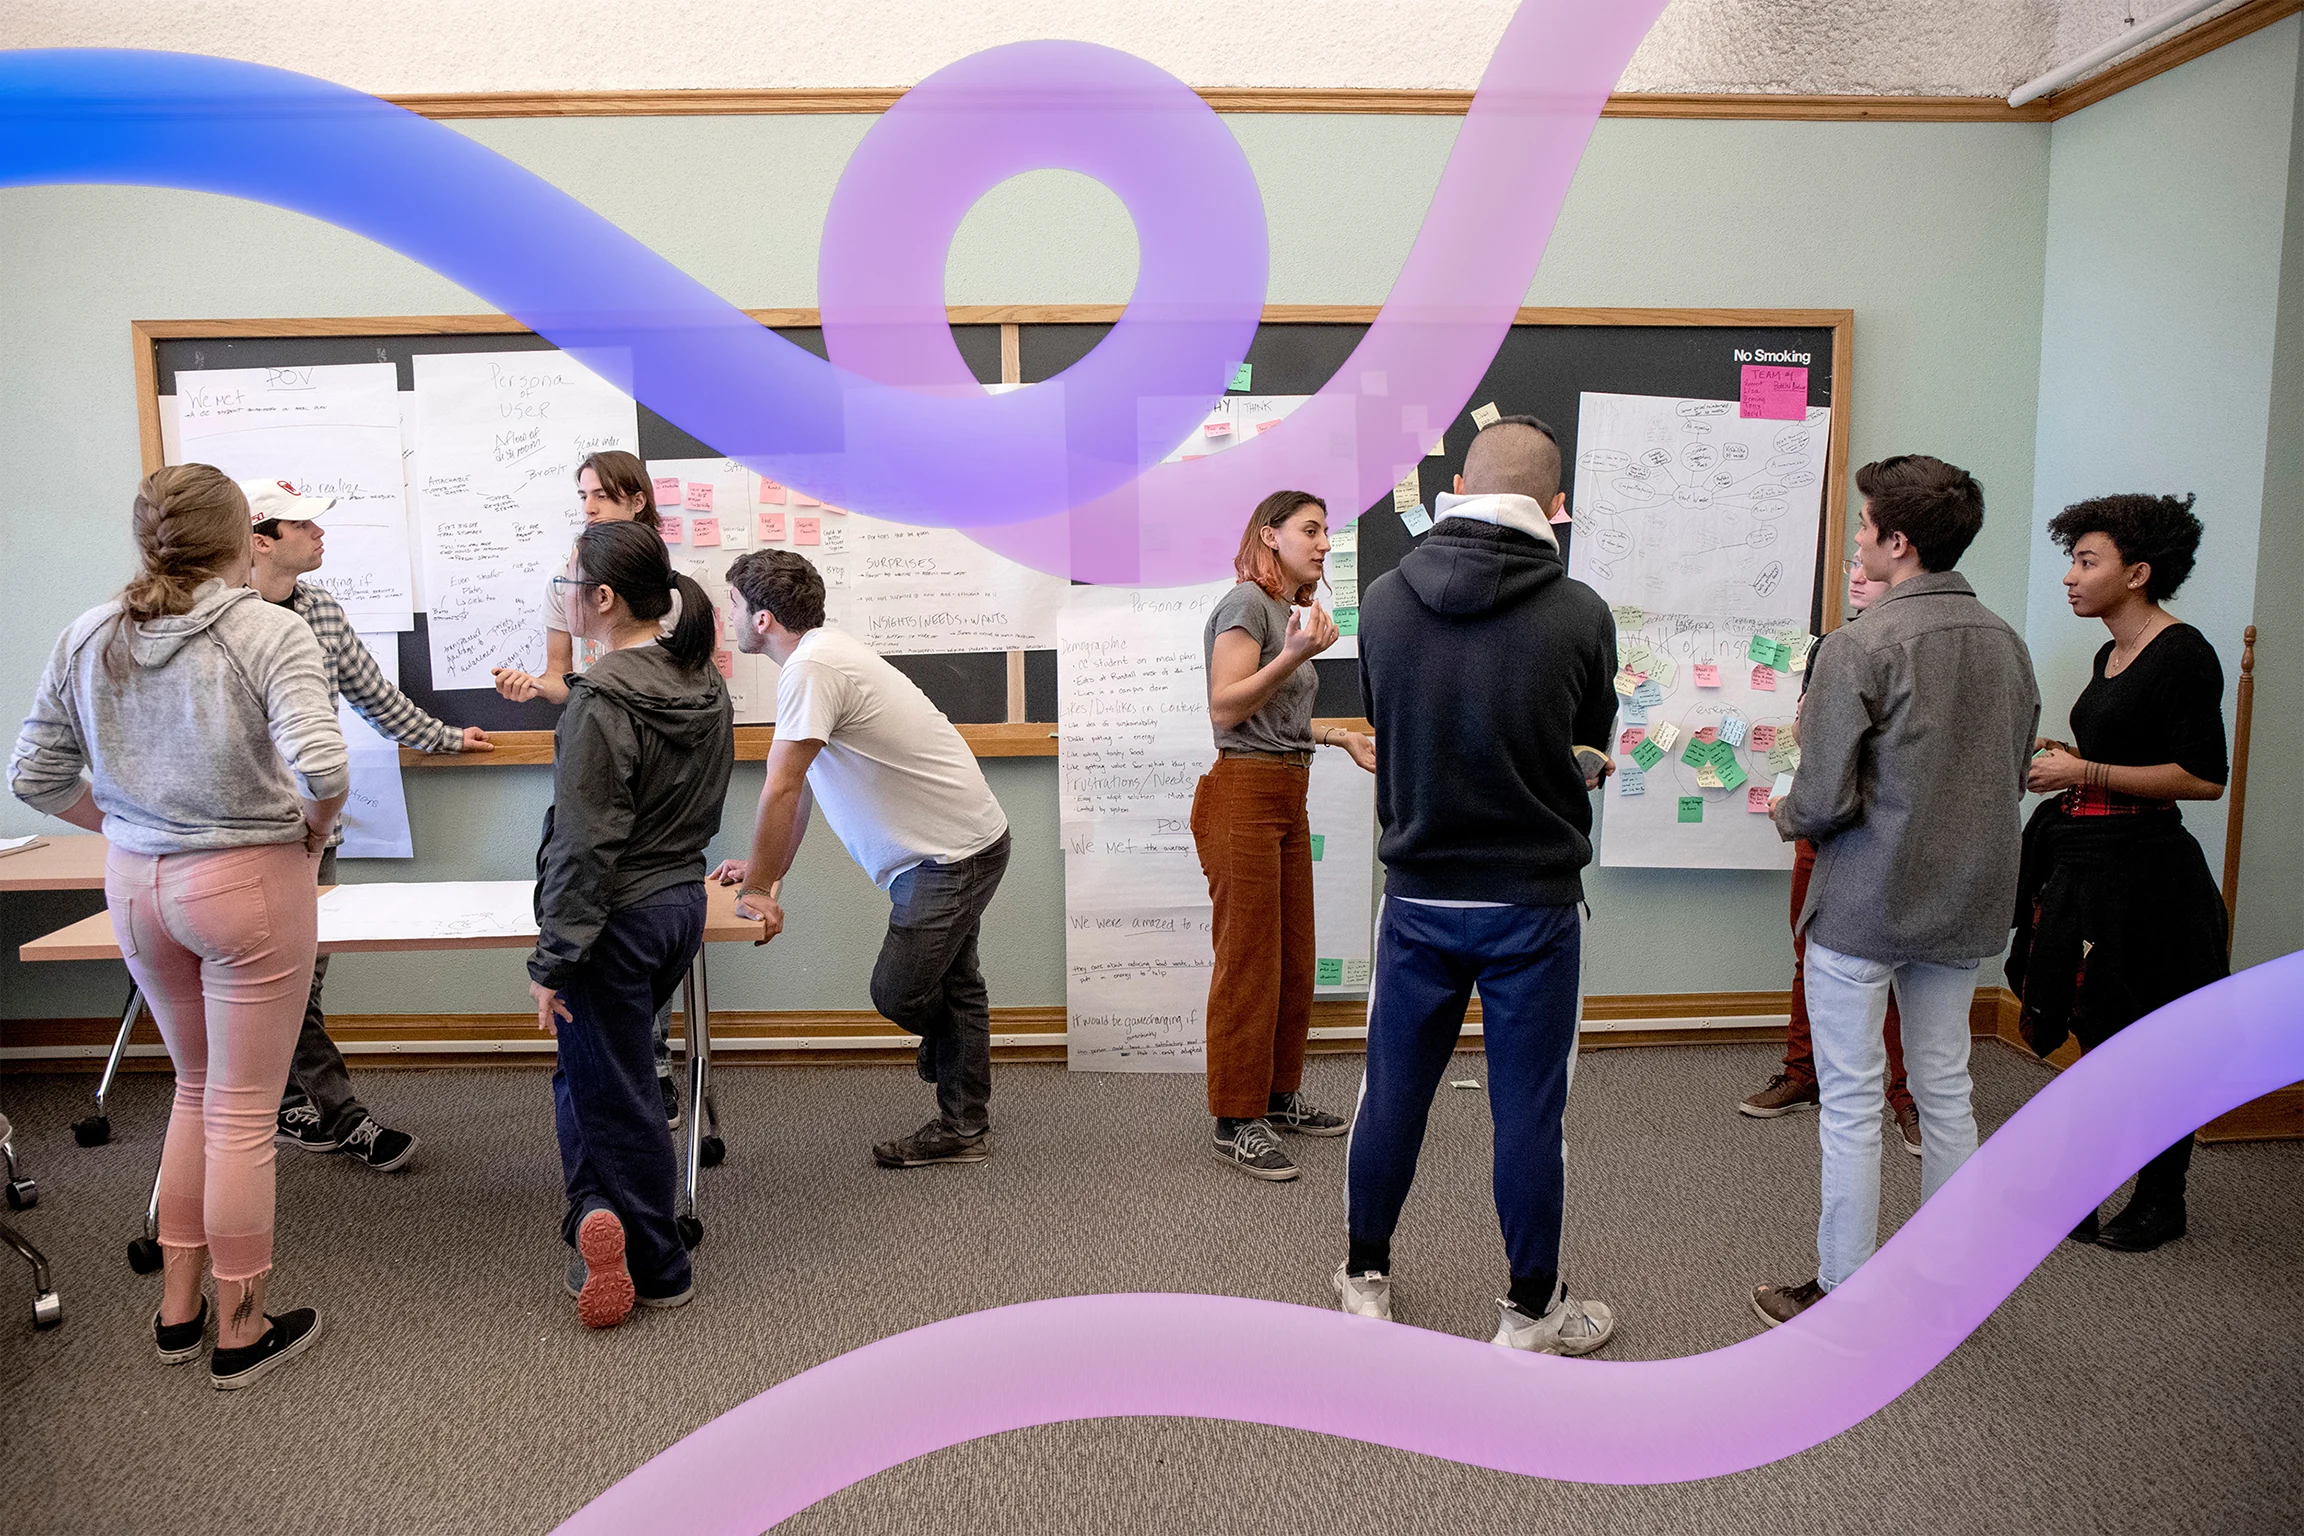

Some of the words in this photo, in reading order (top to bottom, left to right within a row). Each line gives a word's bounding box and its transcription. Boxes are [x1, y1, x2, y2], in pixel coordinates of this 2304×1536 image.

[1734, 349, 1752, 362] No
[1754, 349, 1811, 365] Smoking
[265, 367, 313, 387] POV
[487, 362, 574, 389] Persona
[1751, 369, 1780, 381] TEAM
[185, 386, 212, 408] We
[1243, 400, 1272, 414] THINK
[428, 475, 471, 487] ATTACHABLE
[866, 557, 937, 570] SURPRISES
[360, 573, 373, 586] if
[450, 576, 470, 587] Even
[1130, 592, 1182, 613] Persona
[1188, 594, 1210, 613] of
[970, 612, 1008, 627] WANTS
[1061, 634, 1129, 658] Demographic
[1683, 629, 1702, 666] of
[1093, 655, 1129, 668] student
[1156, 652, 1176, 663] meal
[1179, 652, 1197, 663] plan
[1161, 667, 1169, 676] of
[1190, 664, 1205, 672] time
[1118, 686, 1144, 694] campus
[1149, 683, 1169, 692] dorm
[1142, 704, 1154, 713] in
[1160, 701, 1203, 716] Context
[1695, 705, 1741, 717] events
[1116, 719, 1158, 729] sustainability
[1091, 735, 1113, 746] putting
[1133, 734, 1156, 745] energy
[1083, 751, 1101, 762] eating
[1106, 750, 1125, 759] tasty
[1129, 748, 1145, 756] food
[1066, 763, 1080, 771] Like
[1084, 763, 1106, 775] getting
[1131, 761, 1144, 769] for
[1148, 760, 1165, 768] what
[1171, 762, 1186, 771] they
[1107, 794, 1122, 802] adopt
[1099, 806, 1106, 814] by
[1157, 818, 1191, 833] POV
[1070, 834, 1096, 855] We
[1144, 843, 1159, 852] the
[1163, 845, 1190, 857] average
[1070, 915, 1091, 929] We
[1095, 917, 1123, 930] were
[1132, 917, 1176, 932] amazed
[1181, 917, 1192, 930] to
[1072, 966, 1087, 974] they
[1091, 963, 1104, 971] care
[1127, 961, 1152, 972] reducing
[1155, 959, 1168, 967] food
[1113, 972, 1132, 981] energy
[1152, 969, 1167, 978] help
[1072, 1014, 1082, 1028] It
[1083, 1014, 1109, 1027] would
[1112, 1013, 1123, 1027] be
[1186, 1009, 1199, 1025] if
